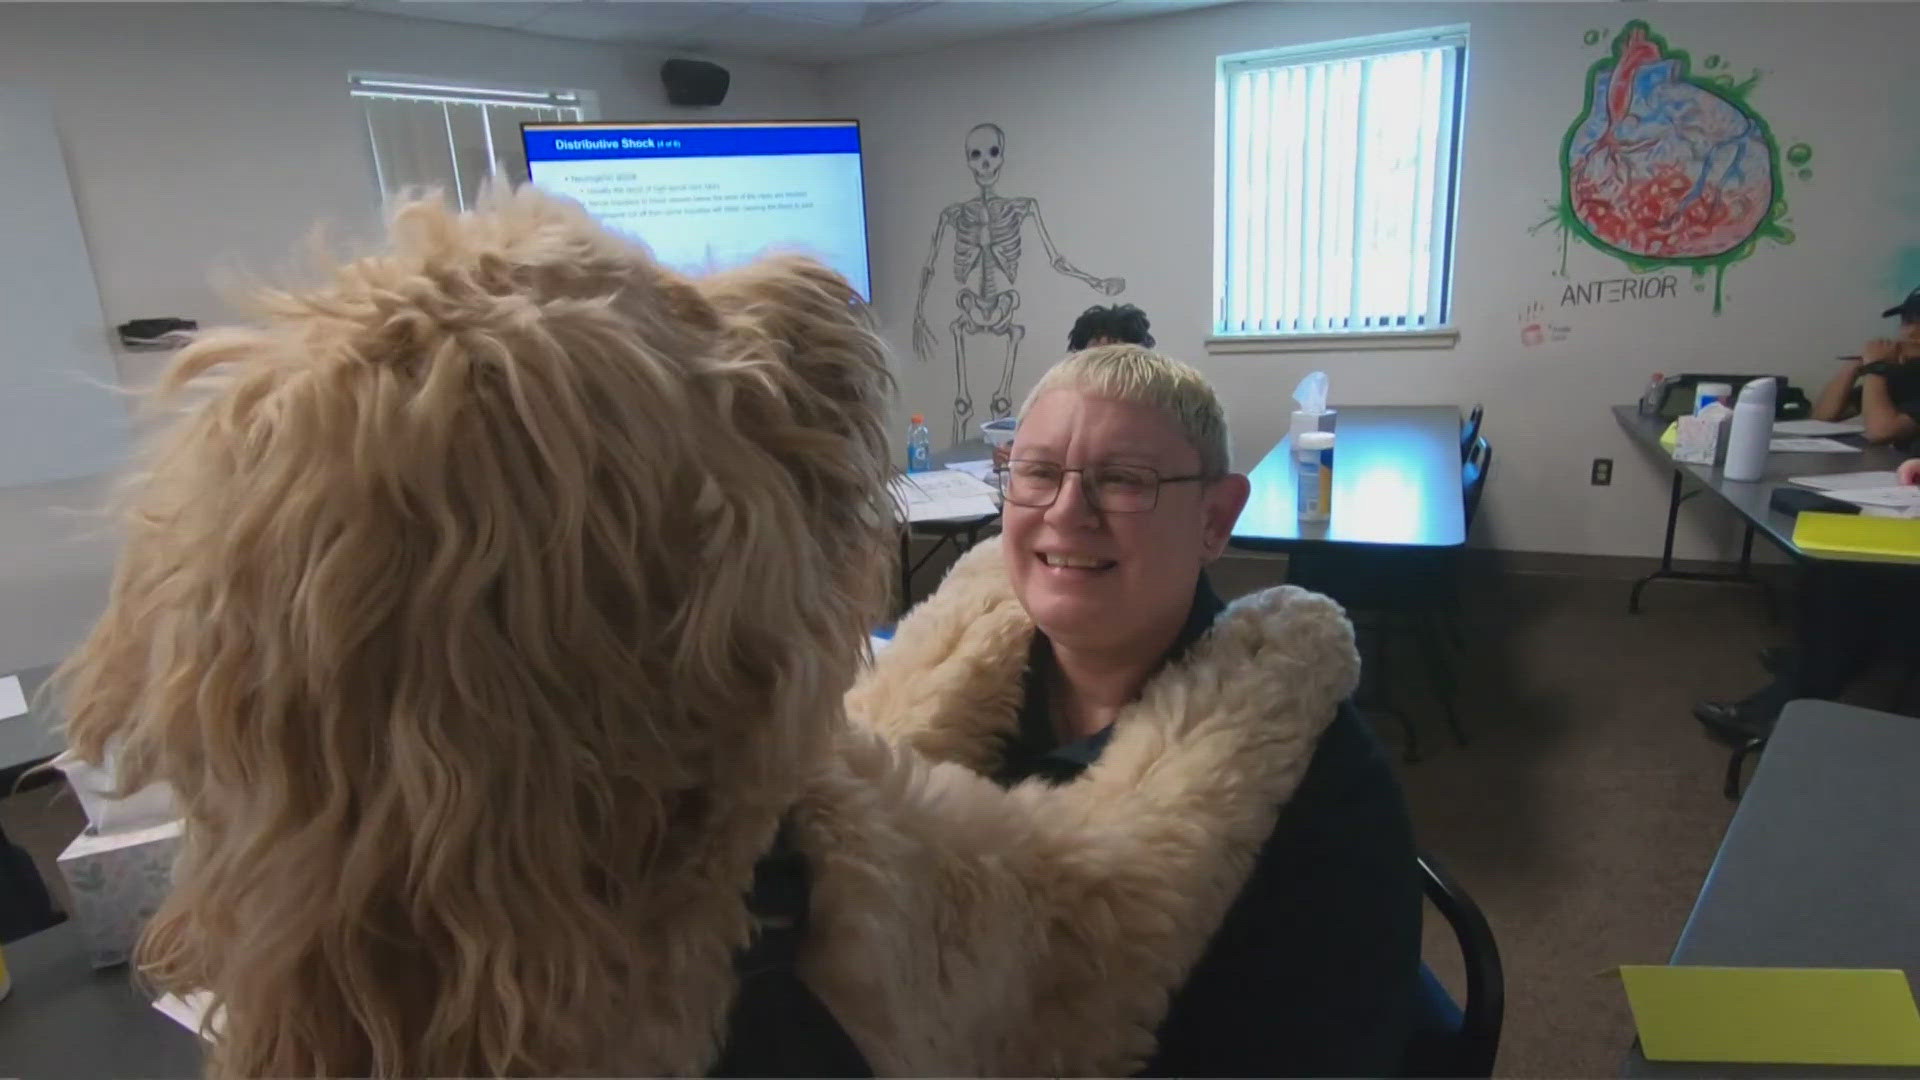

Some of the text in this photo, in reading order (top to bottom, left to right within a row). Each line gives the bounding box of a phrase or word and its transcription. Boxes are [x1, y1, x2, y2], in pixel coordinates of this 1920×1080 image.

[555, 139, 619, 150] Distributive
[621, 137, 656, 148] Shock
[1560, 275, 1678, 307] ANTERIOR
